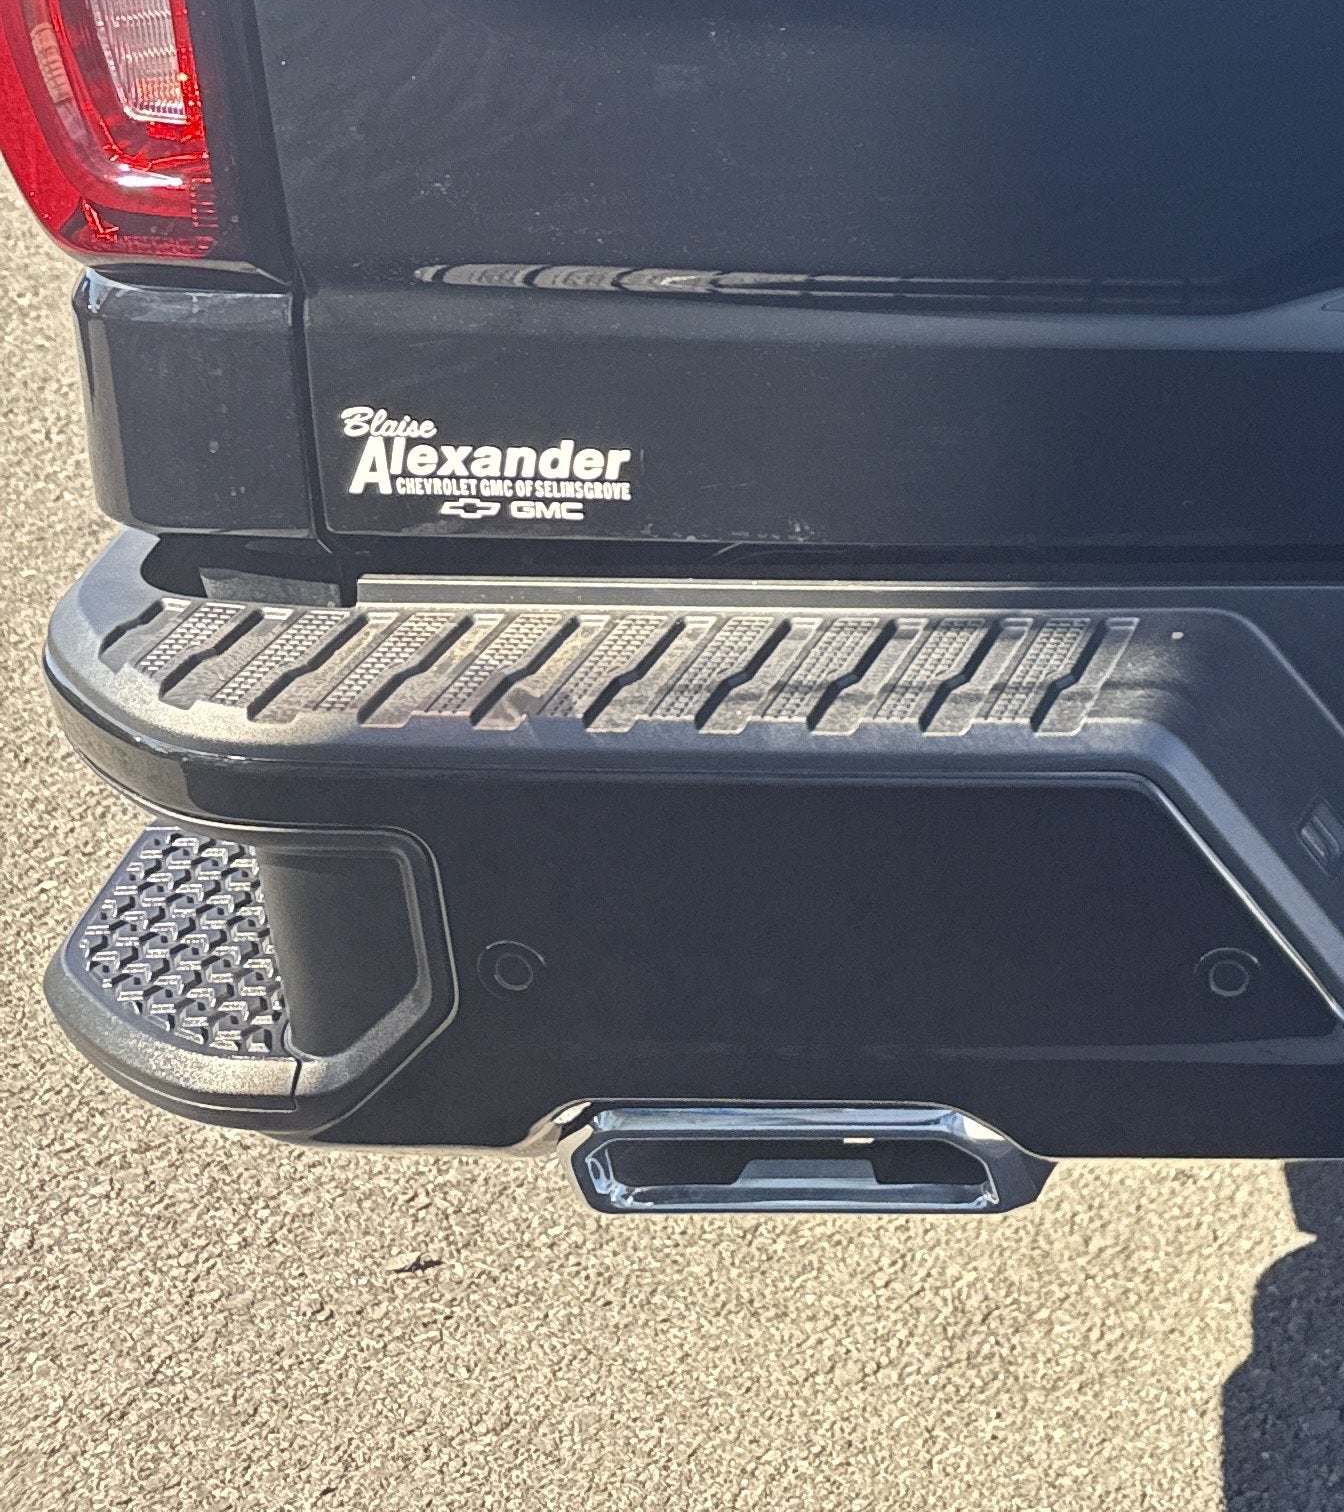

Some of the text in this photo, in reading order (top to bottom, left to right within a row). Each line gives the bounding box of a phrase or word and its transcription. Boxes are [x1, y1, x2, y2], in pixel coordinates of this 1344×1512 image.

[341, 405, 437, 438] Blaise
[349, 435, 631, 495] Alexander
[395, 476, 632, 501] CHEVROLET GMC OF SELINSGROVE
[510, 500, 584, 520] GMC
